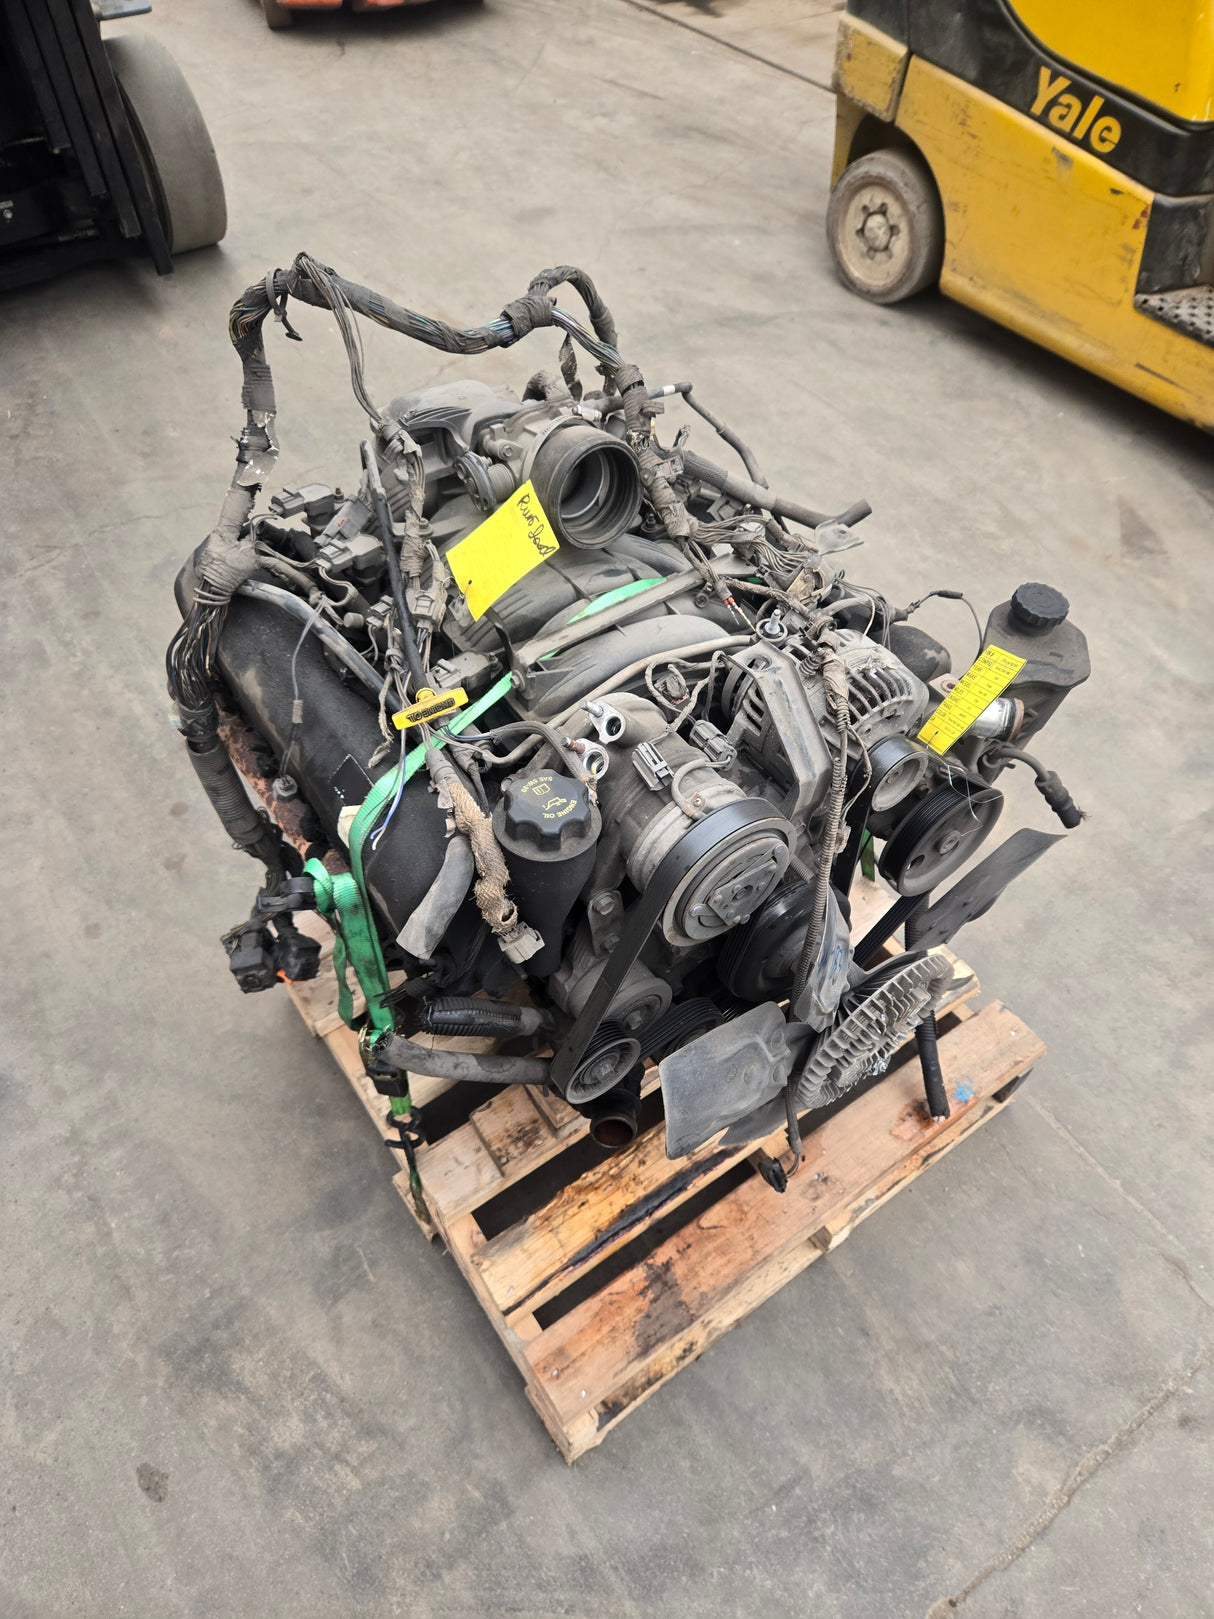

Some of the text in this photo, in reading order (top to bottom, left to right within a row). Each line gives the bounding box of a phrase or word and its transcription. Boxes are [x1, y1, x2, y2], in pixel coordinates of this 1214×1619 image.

[1030, 65, 1121, 153] Yale
[406, 698, 456, 722] ENGINE OIL
[556, 799, 578, 818] ENGINE
